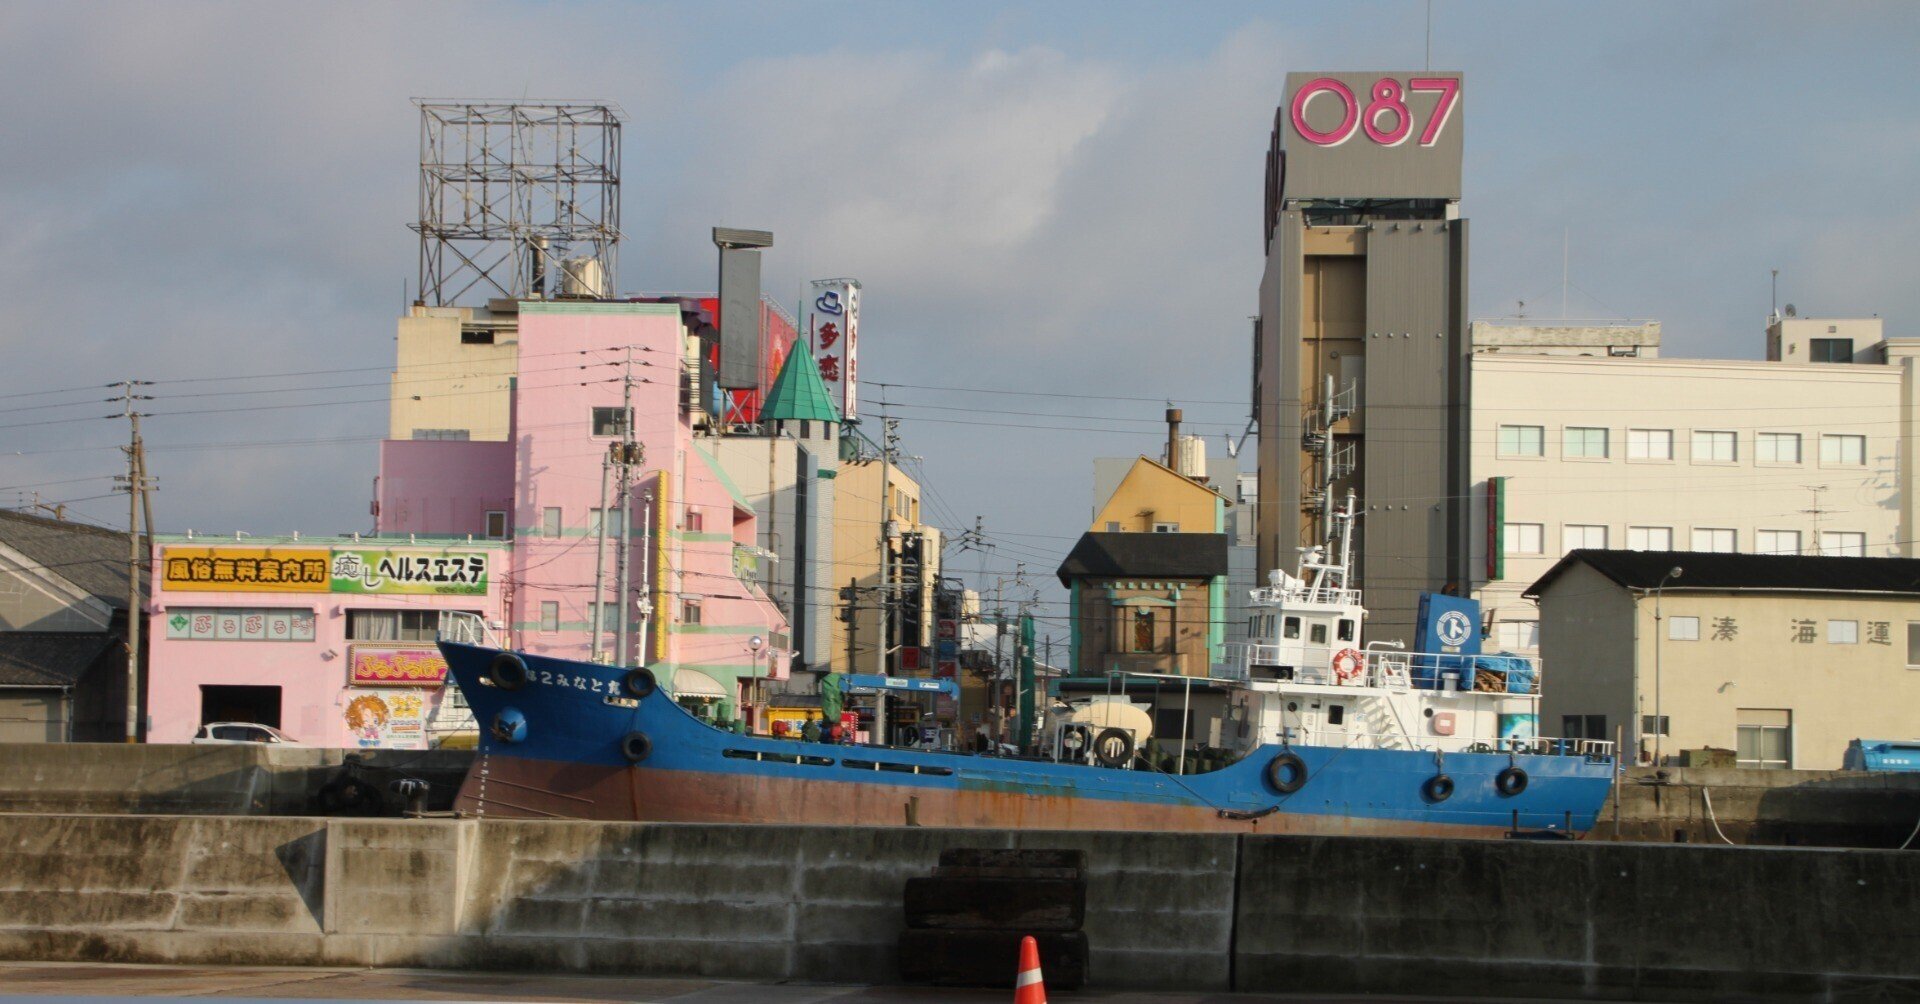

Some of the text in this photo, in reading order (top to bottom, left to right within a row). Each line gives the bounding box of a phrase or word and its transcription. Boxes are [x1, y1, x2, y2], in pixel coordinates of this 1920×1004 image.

[167, 557, 326, 583] 風俗無料案内所
[1711, 616, 1892, 646] 湊海運
